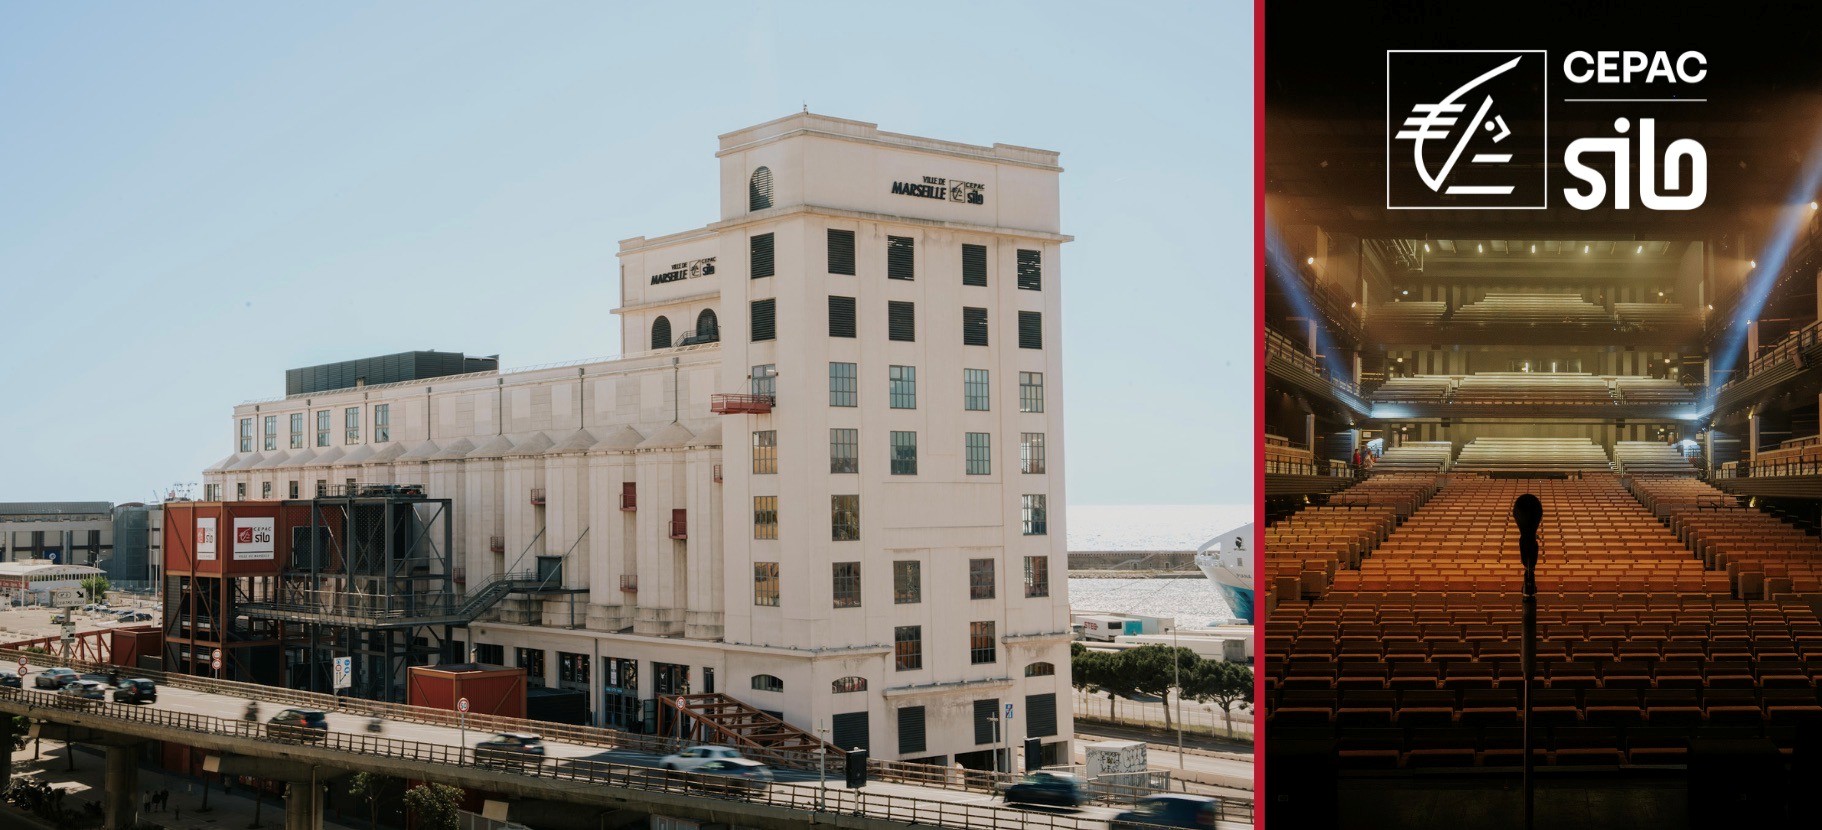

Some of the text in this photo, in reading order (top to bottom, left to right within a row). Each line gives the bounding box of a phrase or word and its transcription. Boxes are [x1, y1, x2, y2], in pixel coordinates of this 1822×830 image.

[922, 176, 938, 185] VILLE
[965, 181, 985, 190] CEPAC
[891, 180, 947, 201] MARSEILLE
[650, 269, 688, 286] MARSEILLE
[255, 532, 271, 543] silo
